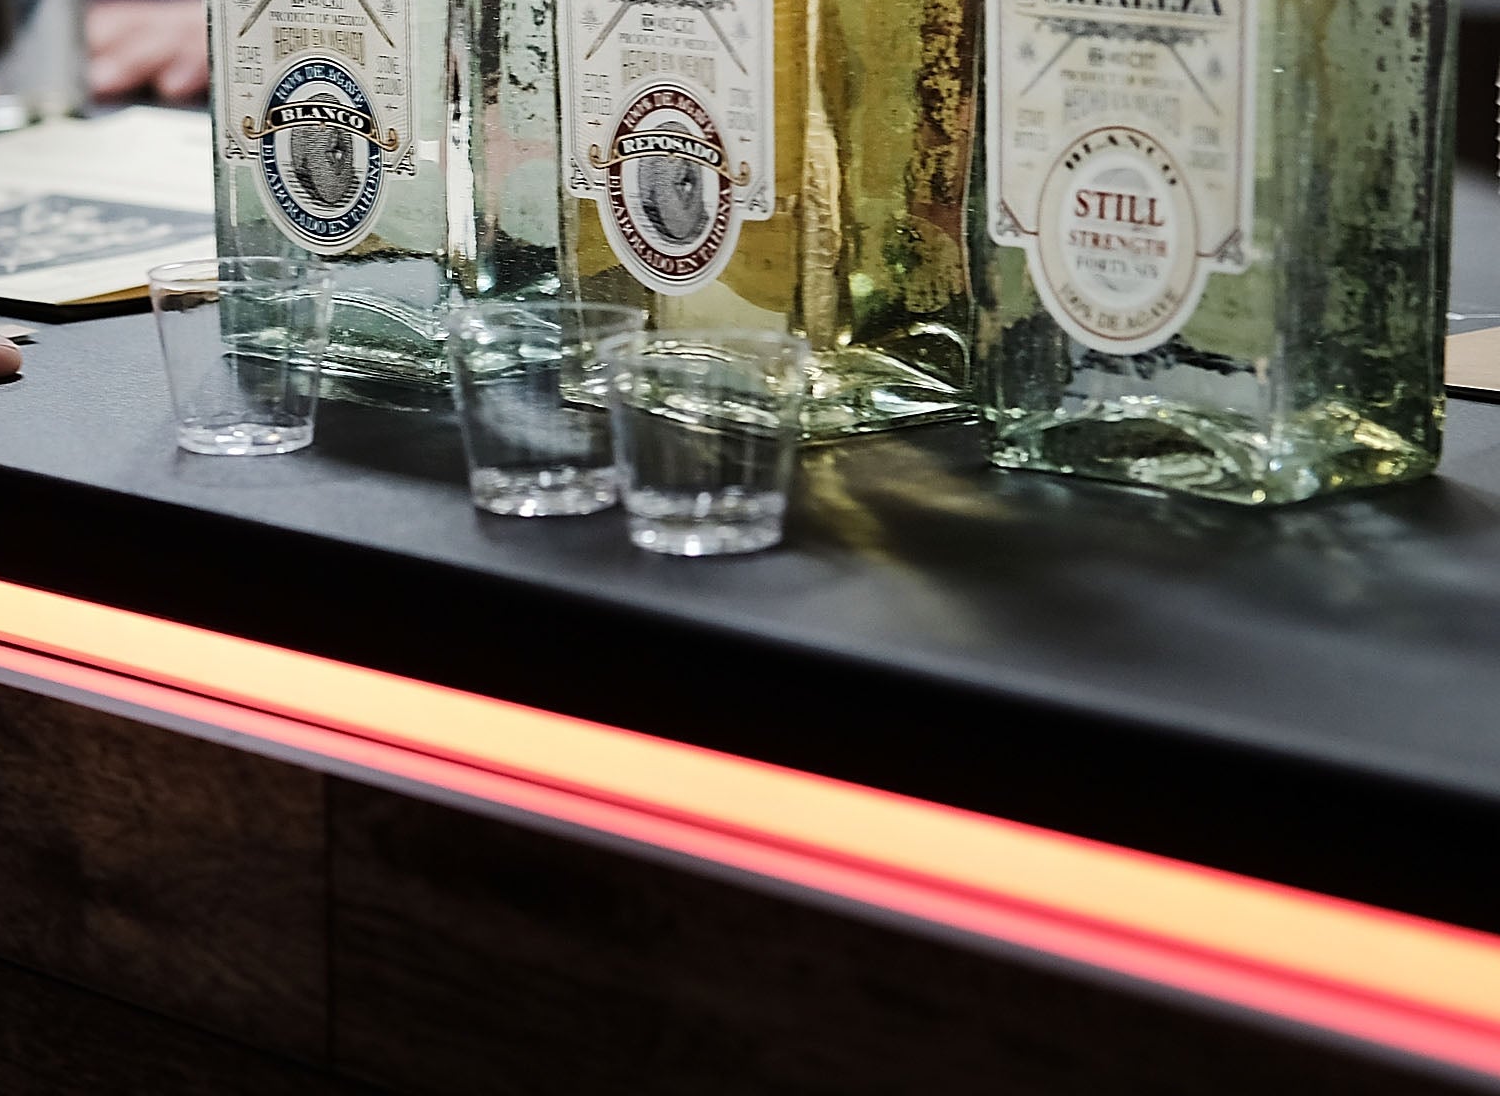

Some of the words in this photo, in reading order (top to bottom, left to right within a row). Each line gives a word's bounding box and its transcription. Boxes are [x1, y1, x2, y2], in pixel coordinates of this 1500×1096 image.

[305, 65, 326, 80] DE
[652, 91, 675, 107] DE
[280, 107, 365, 129] BLANCO
[621, 137, 720, 164] REPOSADO
[1074, 188, 1165, 227] STILL
[1068, 228, 1168, 258] STRENGTH
